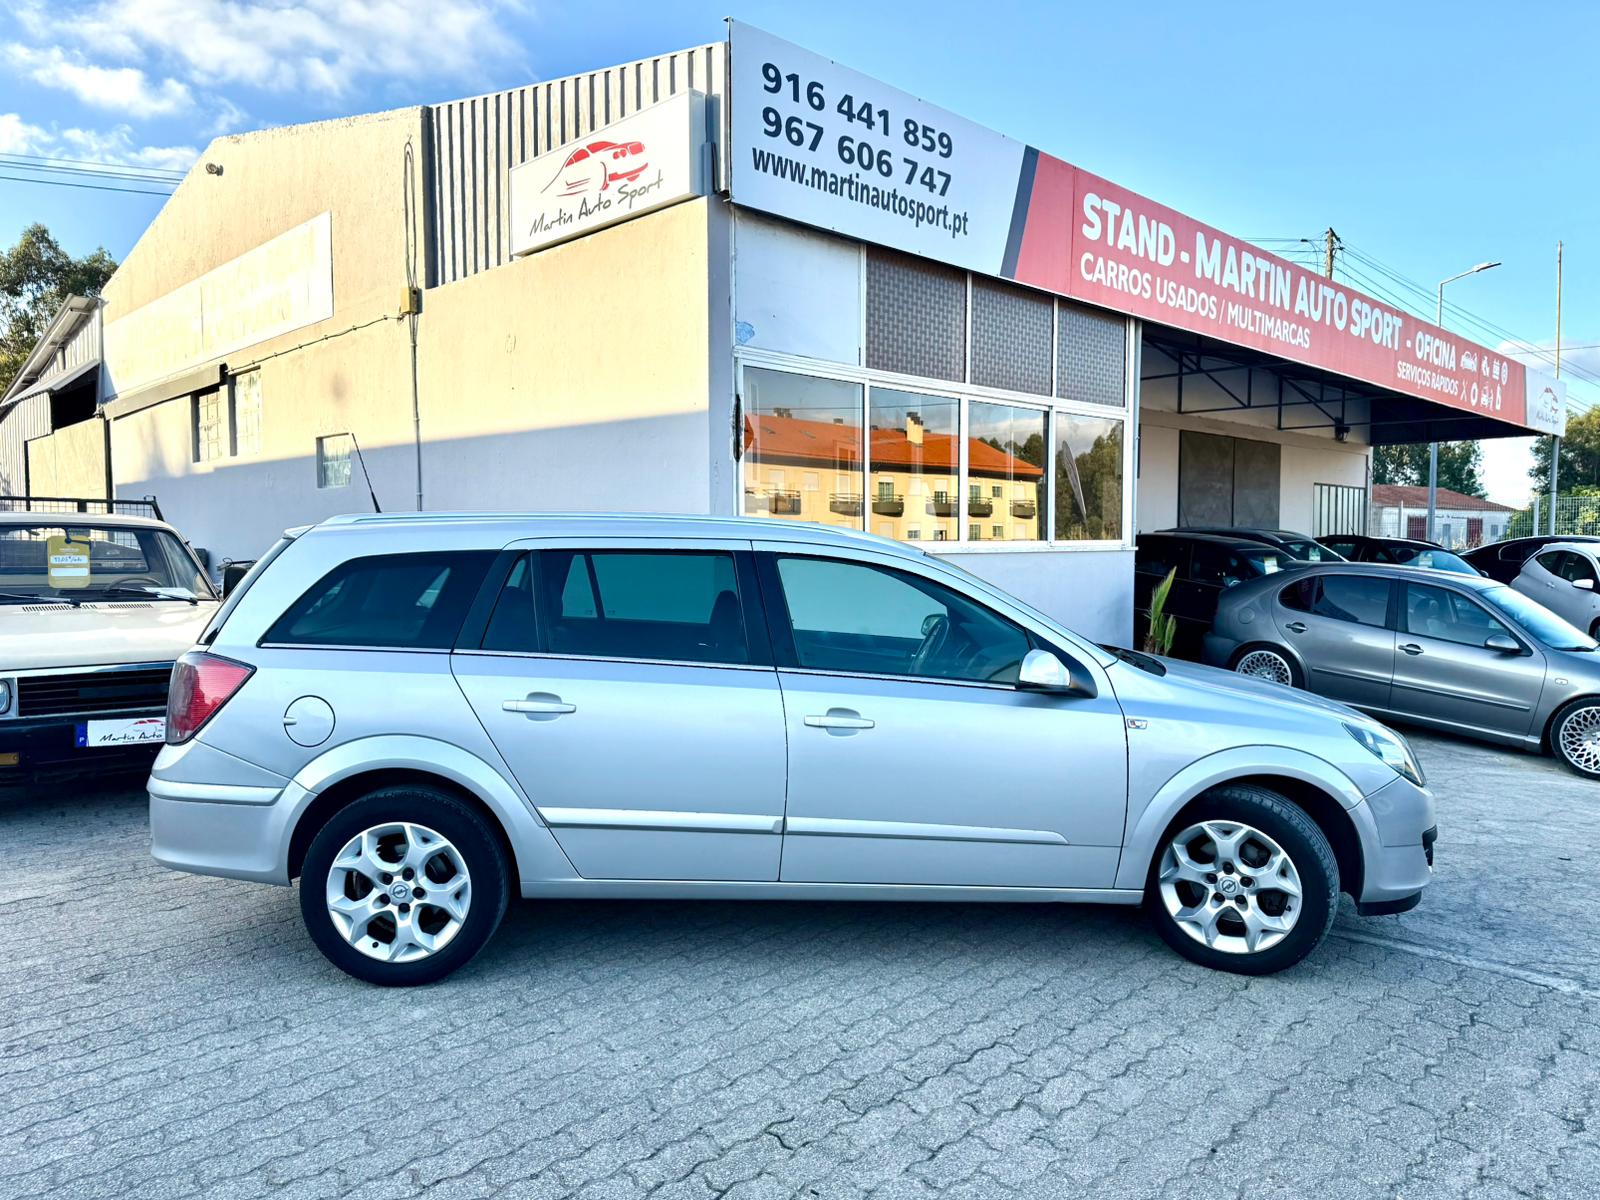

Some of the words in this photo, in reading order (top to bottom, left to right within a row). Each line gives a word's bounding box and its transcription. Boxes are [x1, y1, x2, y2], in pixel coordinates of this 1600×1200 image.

[762, 62, 826, 111] 916
[837, 94, 890, 136] 441
[903, 118, 953, 158] 859
[762, 106, 824, 152] 967
[837, 135, 893, 177] 606
[903, 157, 952, 197] 747
[530, 208, 573, 237] Martin
[578, 193, 612, 220] Auto
[618, 169, 663, 209] Sport
[752, 147, 968, 239] www.martinautosport.pt
[1080, 252, 1151, 300] CARROS
[1156, 277, 1217, 320] USADOS
[1227, 302, 1310, 349] MULTIMARCAS
[1082, 192, 1176, 266] STAND
[1195, 231, 1291, 311] MARTIN
[1295, 275, 1347, 331] AUTO
[1350, 298, 1402, 351] SPORT
[1415, 331, 1457, 372] OFICINA
[1397, 360, 1431, 389] SERVIÇOS
[1431, 369, 1459, 396] RÁPIDOS
[99, 733, 135, 742] Martin
[138, 731, 163, 740] Auto
